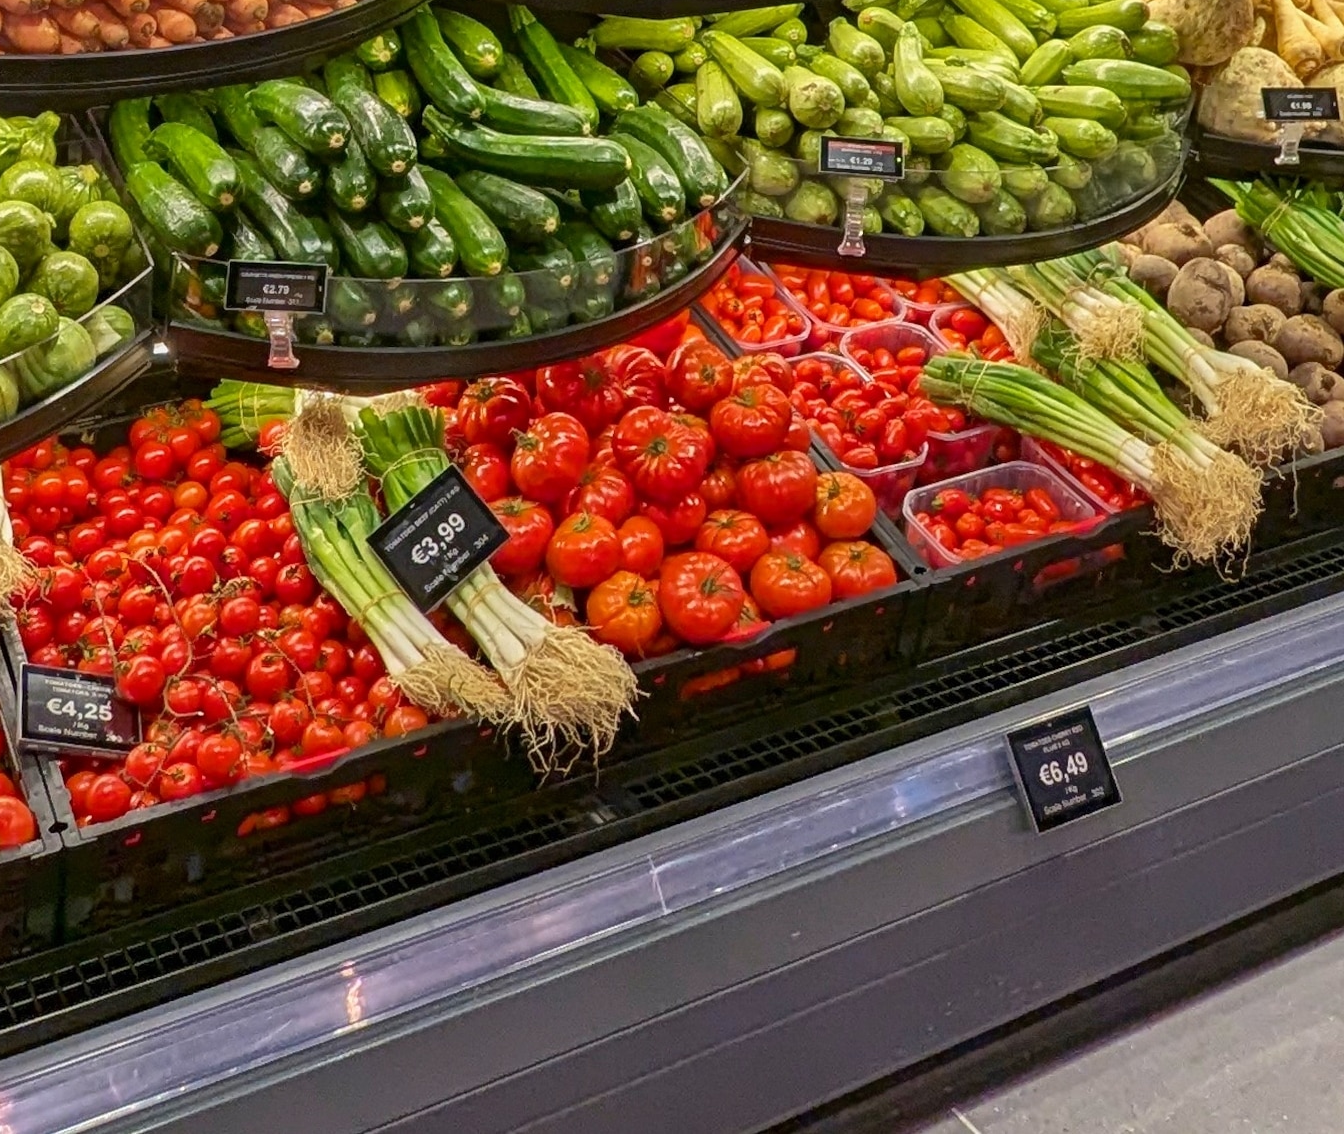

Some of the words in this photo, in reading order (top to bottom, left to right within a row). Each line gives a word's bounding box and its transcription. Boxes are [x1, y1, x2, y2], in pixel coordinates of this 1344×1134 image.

[262, 285, 289, 295] €2.79
[411, 513, 465, 565] €3,99
[425, 574, 445, 593] Scale
[441, 551, 471, 582] Number
[473, 535, 489, 550] 304
[47, 698, 113, 722] €4,25
[38, 724, 62, 735] Scale
[64, 728, 98, 740] Number
[1040, 752, 1088, 786] €6,49
[1044, 802, 1062, 816] Scale
[1062, 794, 1086, 810] Number
